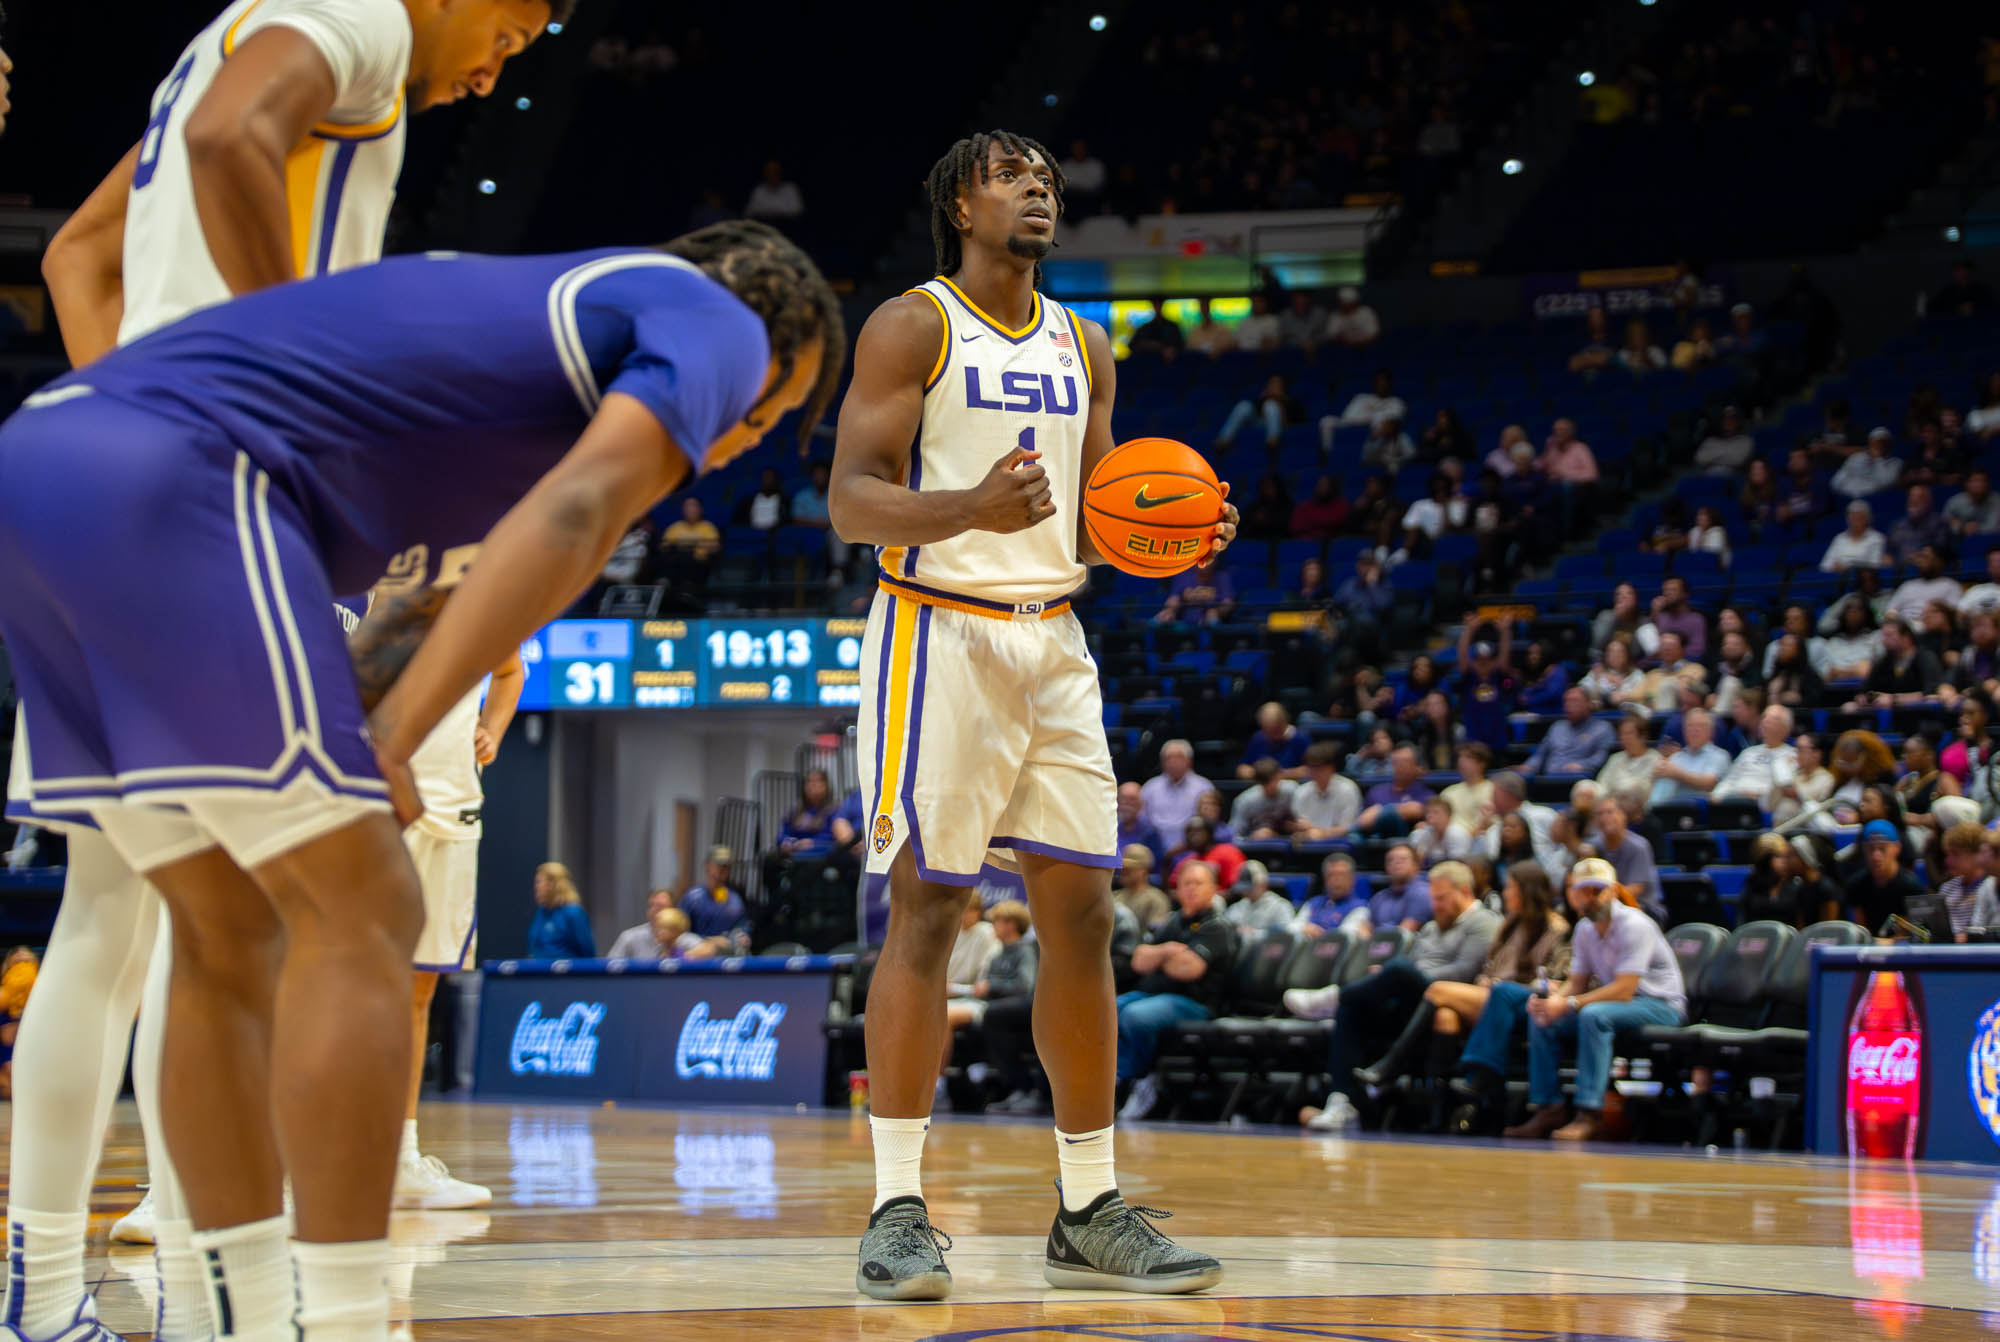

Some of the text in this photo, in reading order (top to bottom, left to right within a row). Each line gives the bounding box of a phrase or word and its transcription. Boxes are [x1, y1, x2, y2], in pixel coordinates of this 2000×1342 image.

[133, 51, 195, 191] 8
[964, 366, 1078, 415] LSU
[1128, 533, 1200, 555] ELITE
[1018, 603, 1041, 614] LSU
[656, 639, 674, 669] 1
[706, 628, 812, 667] 19:13
[564, 661, 615, 704] 31
[771, 674, 793, 701] 2
